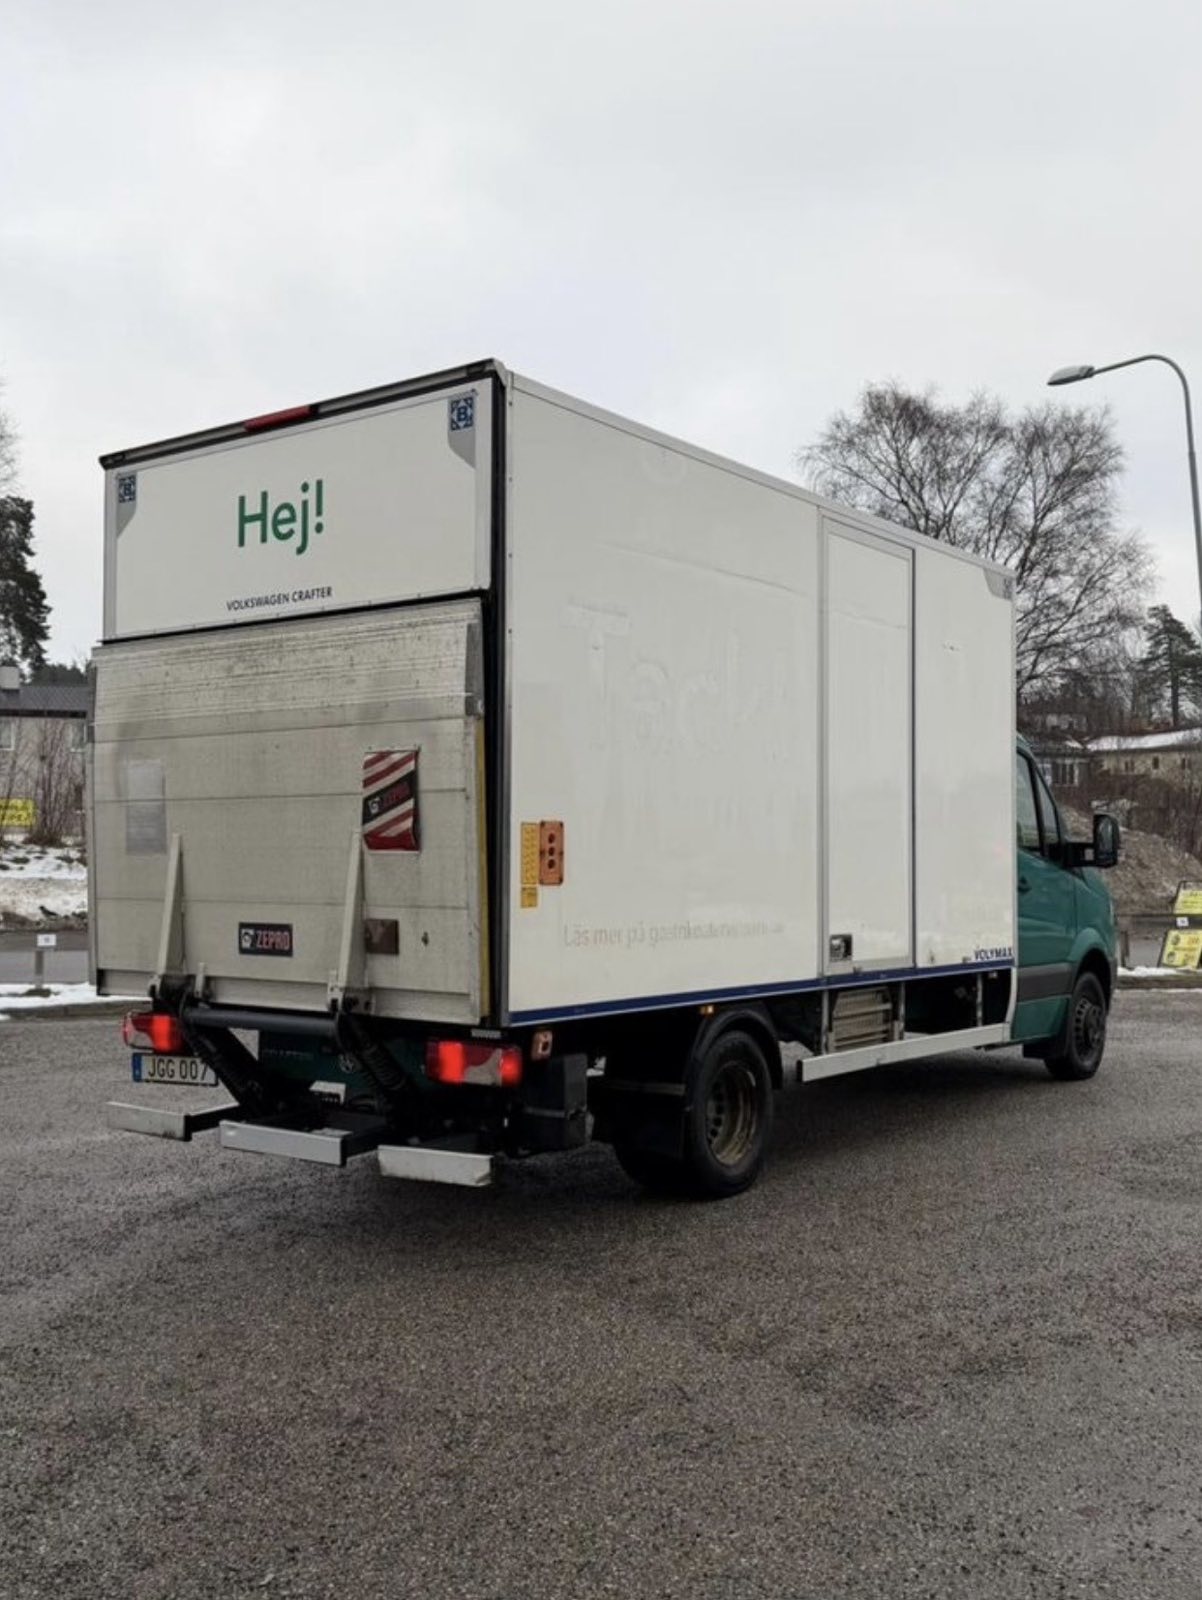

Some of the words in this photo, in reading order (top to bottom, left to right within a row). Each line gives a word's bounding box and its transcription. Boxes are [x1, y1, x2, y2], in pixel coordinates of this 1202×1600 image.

[237, 479, 324, 555] Hej!
[226, 593, 290, 611] VOLKSWAGEN
[292, 586, 333, 603] CRAFTER
[255, 930, 290, 951] ZEPRO
[563, 922, 590, 947] Läs
[593, 927, 621, 945] mer
[626, 920, 646, 950] på
[148, 1056, 176, 1079] JGG
[179, 1059, 209, 1081] 007
